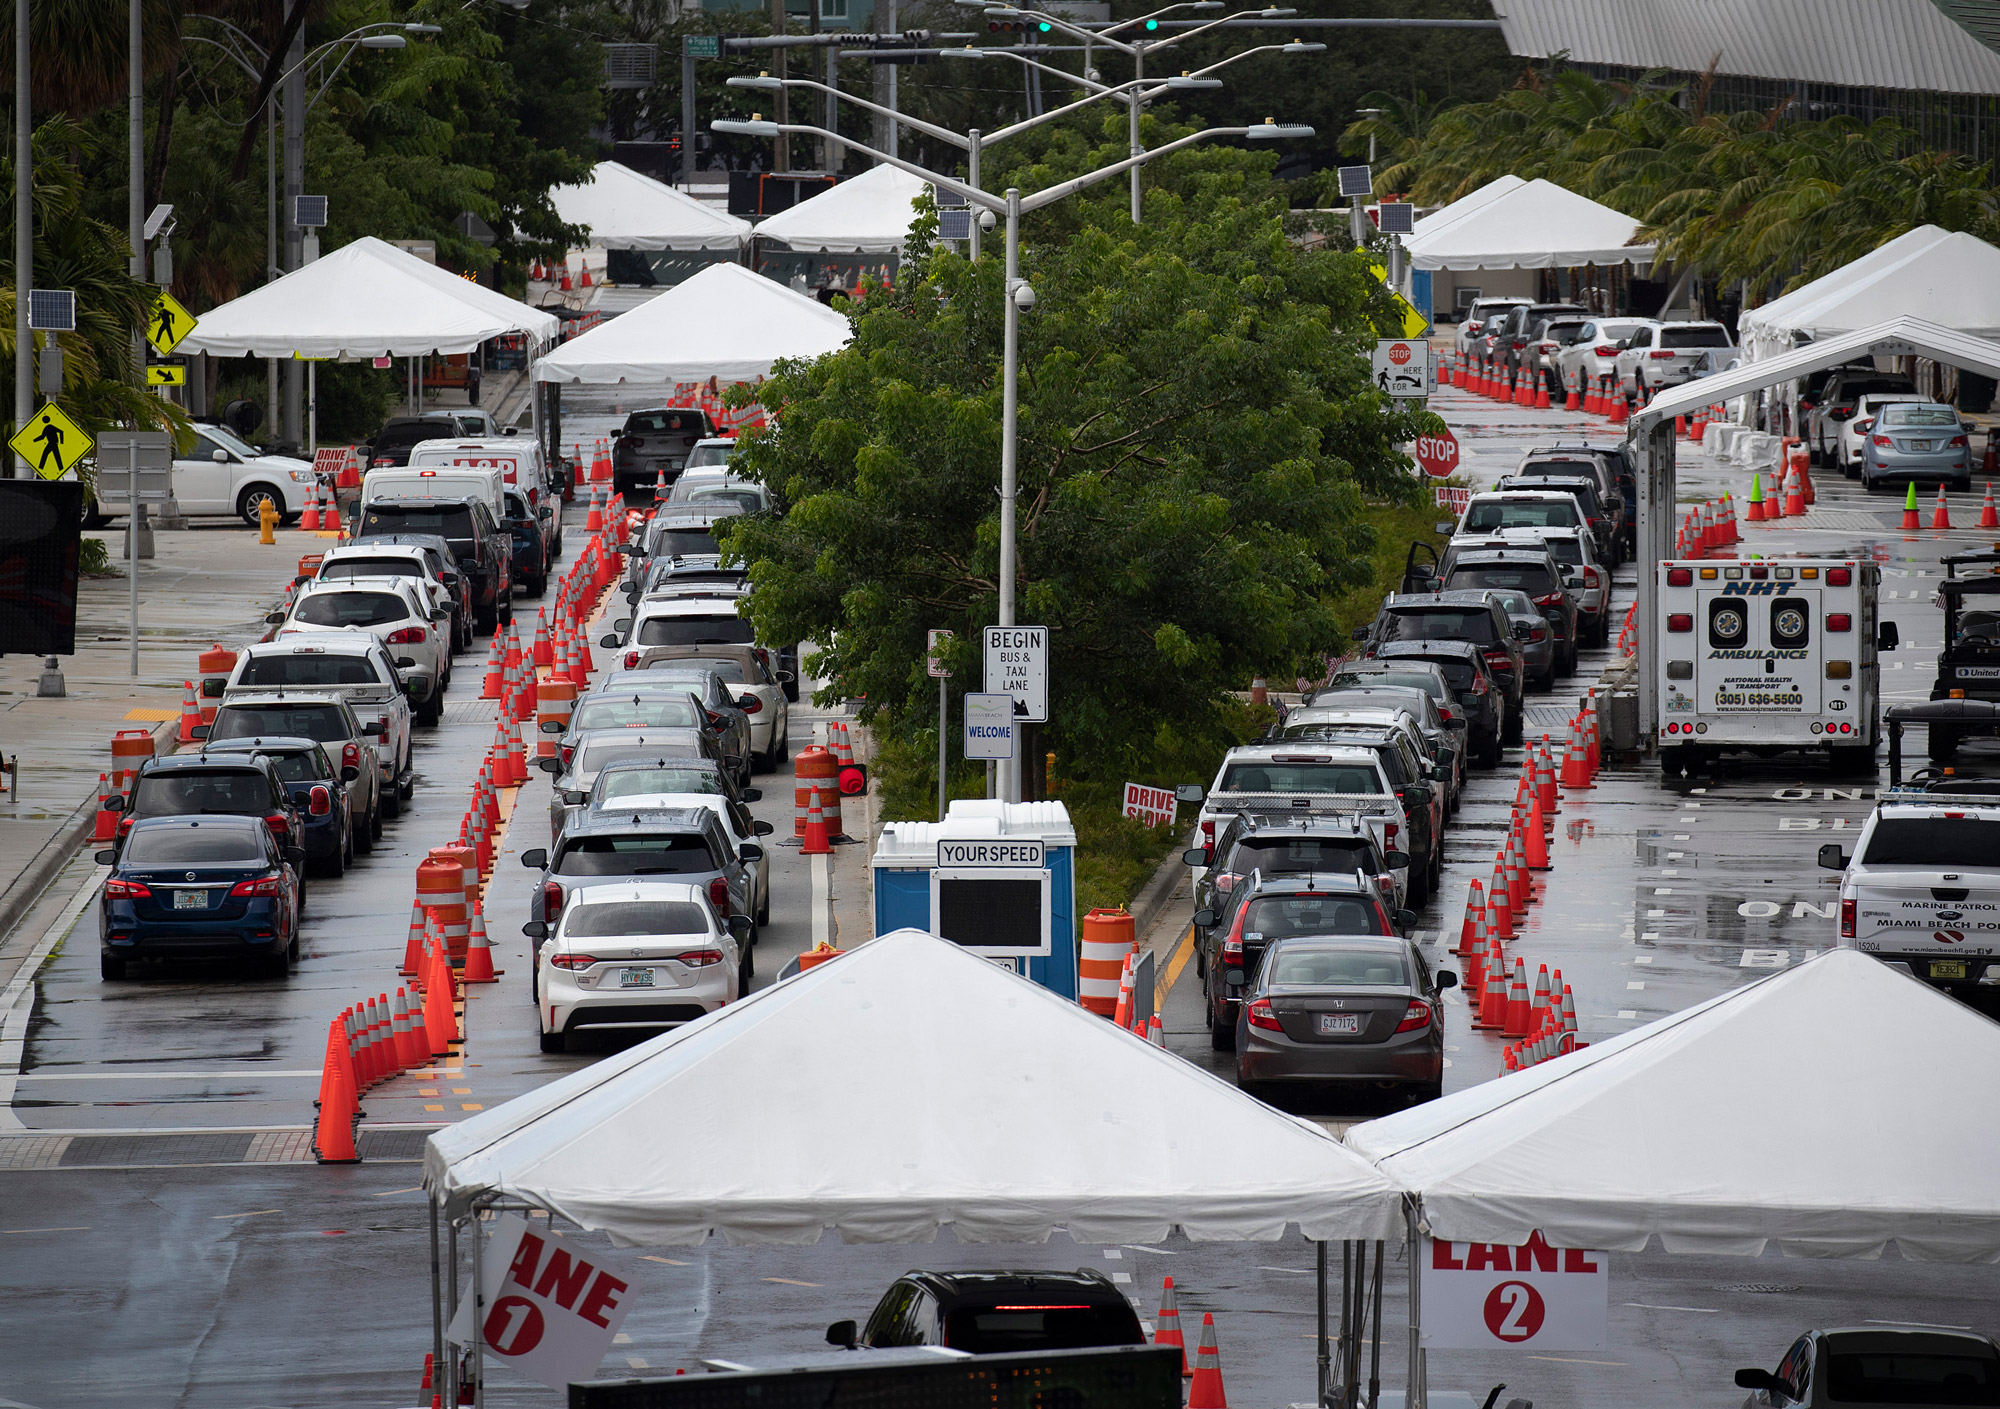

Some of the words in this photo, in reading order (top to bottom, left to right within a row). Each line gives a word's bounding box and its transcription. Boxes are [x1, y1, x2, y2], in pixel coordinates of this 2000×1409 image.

[1389, 349, 1411, 359] STOP
[1403, 366, 1423, 375] HERE
[1392, 382, 1408, 391] FOR
[1419, 436, 1456, 462] STOP
[316, 449, 347, 461] DRIVE
[314, 461, 343, 473] SLOW
[1438, 488, 1470, 501] DRIVE
[1721, 581, 1798, 596] NHT
[991, 632, 1041, 648] BEGIN
[1000, 652, 1020, 663] BUS
[1022, 652, 1031, 663] &
[1707, 649, 1809, 660] AMBULANCE
[1006, 666, 1027, 677] TAXI
[1970, 669, 2000, 677] United
[1003, 680, 1029, 691] LANE
[1715, 692, 1746, 706] (305)
[1748, 693, 1803, 705] 636-5500
[1830, 701, 1847, 710] M11
[968, 726, 1011, 738] WELCOME
[1127, 785, 1175, 812] DRIVE
[1778, 817, 1868, 831] BU
[1737, 901, 1839, 918] ON
[1954, 903, 1998, 911] PATROL
[1876, 919, 1921, 928] MIAMI
[1928, 921, 1971, 929] BEACH
[1977, 922, 2000, 930] PO
[1859, 942, 1881, 951] 15204
[1901, 946, 1977, 955] www.miamibeachfl.gov
[1323, 1018, 1337, 1029] GJZ
[510, 1231, 629, 1330] ANE
[1499, 1284, 1530, 1336] 2
[496, 1304, 532, 1351] 1
